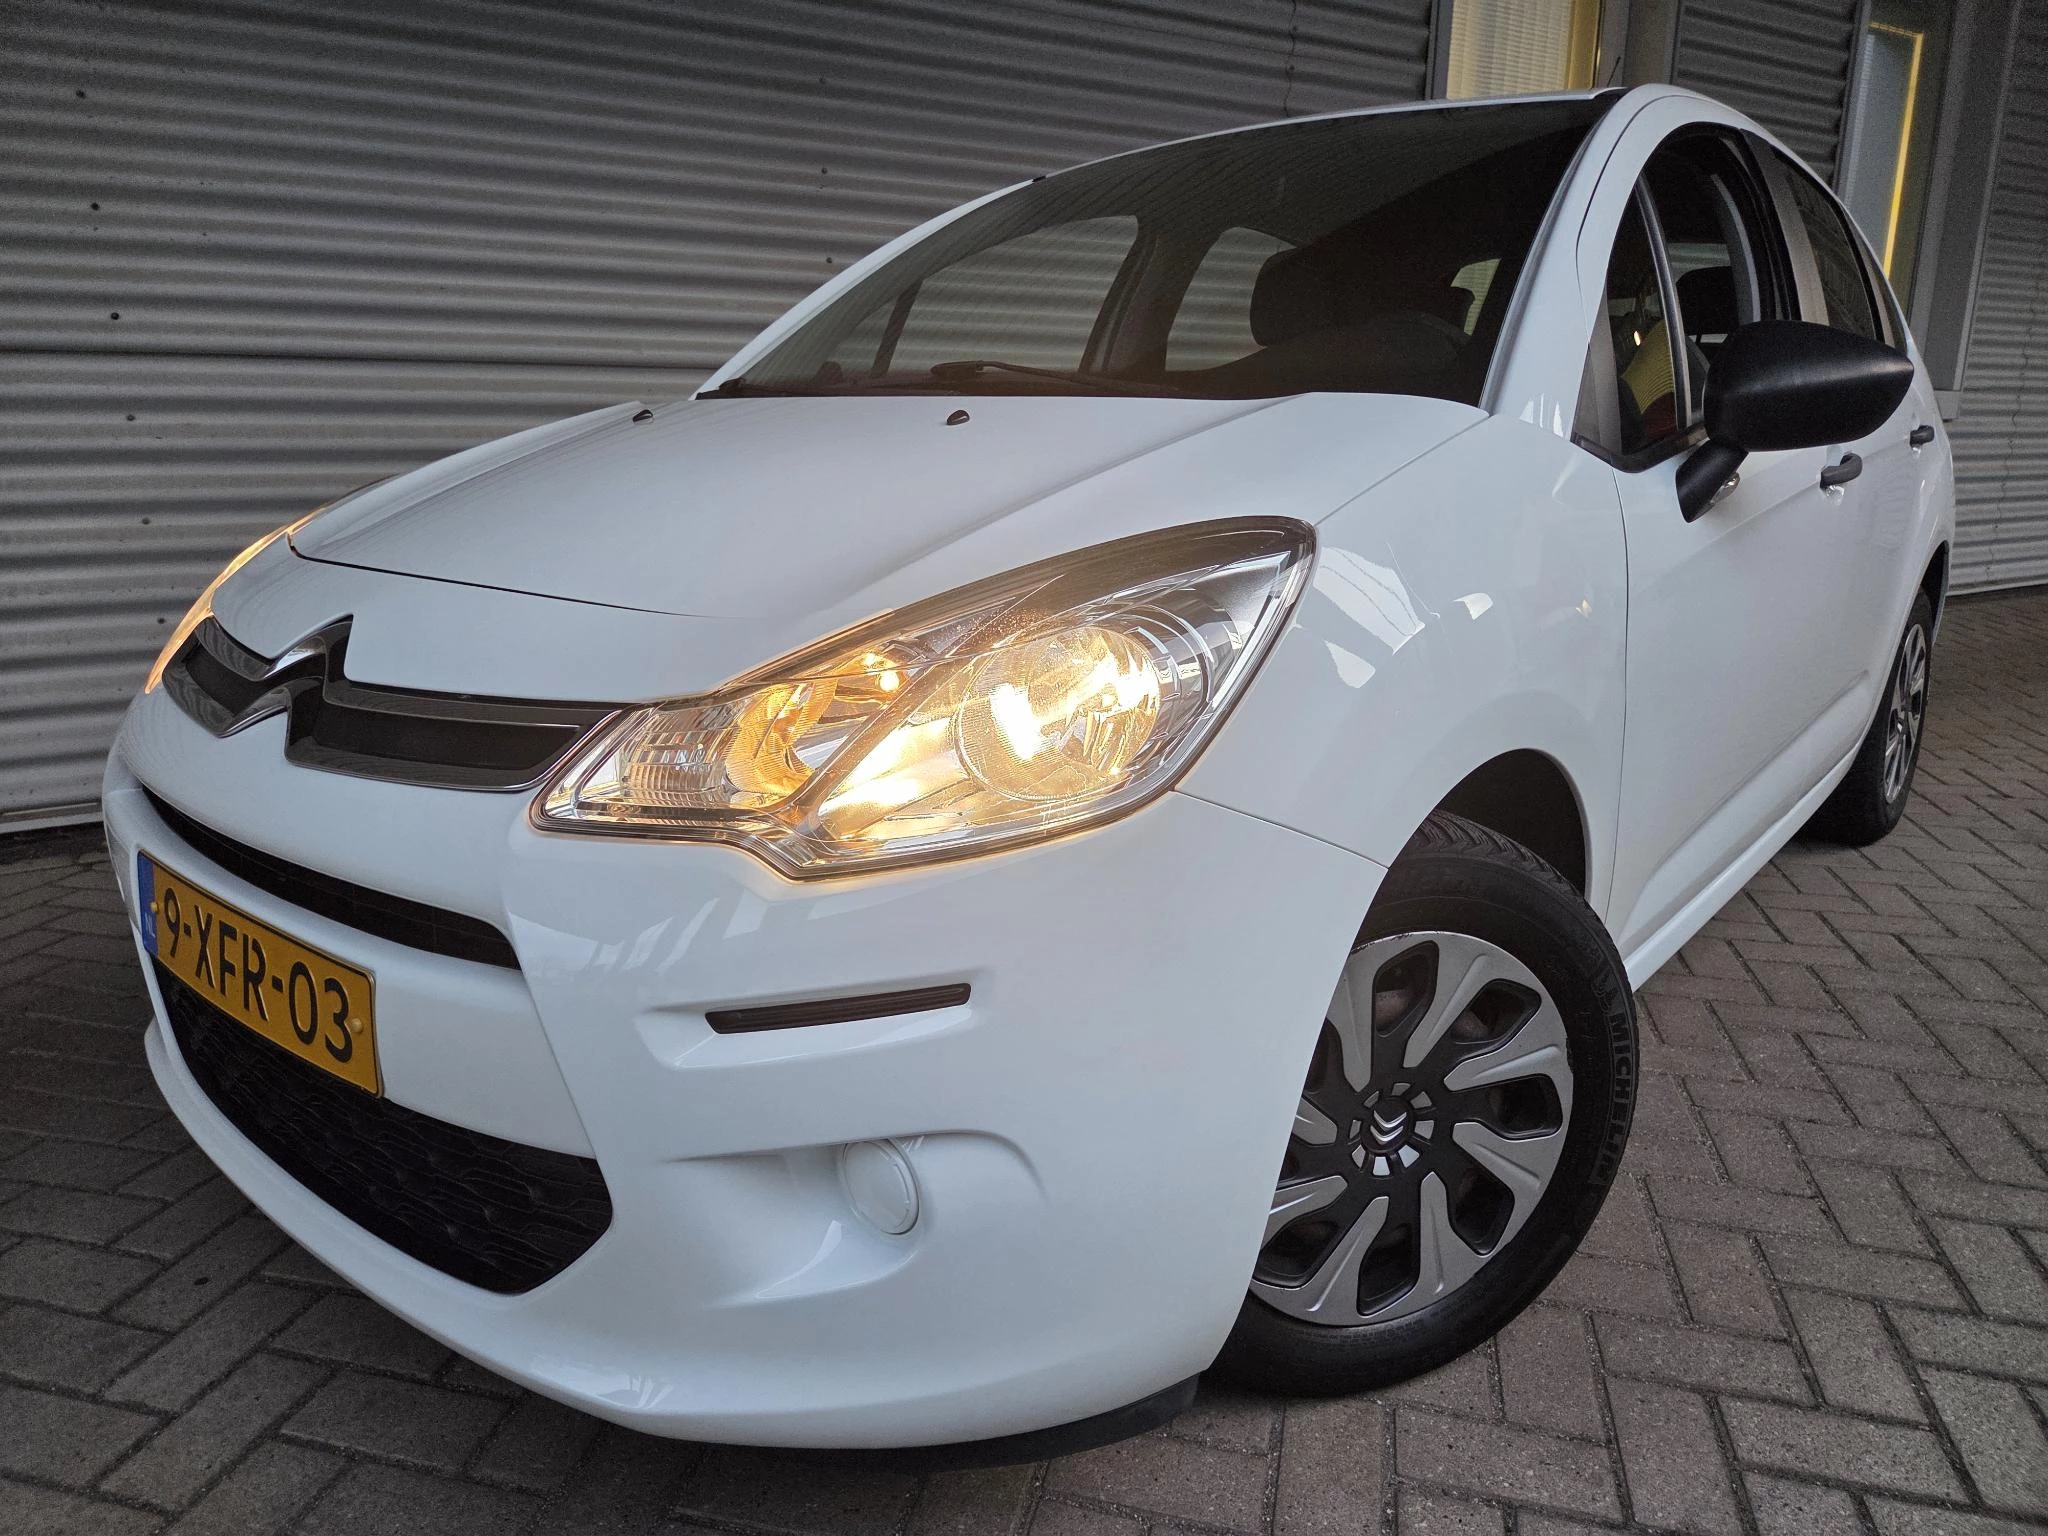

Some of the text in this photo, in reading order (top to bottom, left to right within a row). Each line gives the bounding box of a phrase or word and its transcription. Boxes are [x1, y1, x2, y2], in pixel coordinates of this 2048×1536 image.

[144, 912, 156, 938] NL
[164, 888, 352, 1063] 9-XFR-03
[1598, 1012, 1631, 1180] MICHELIN
